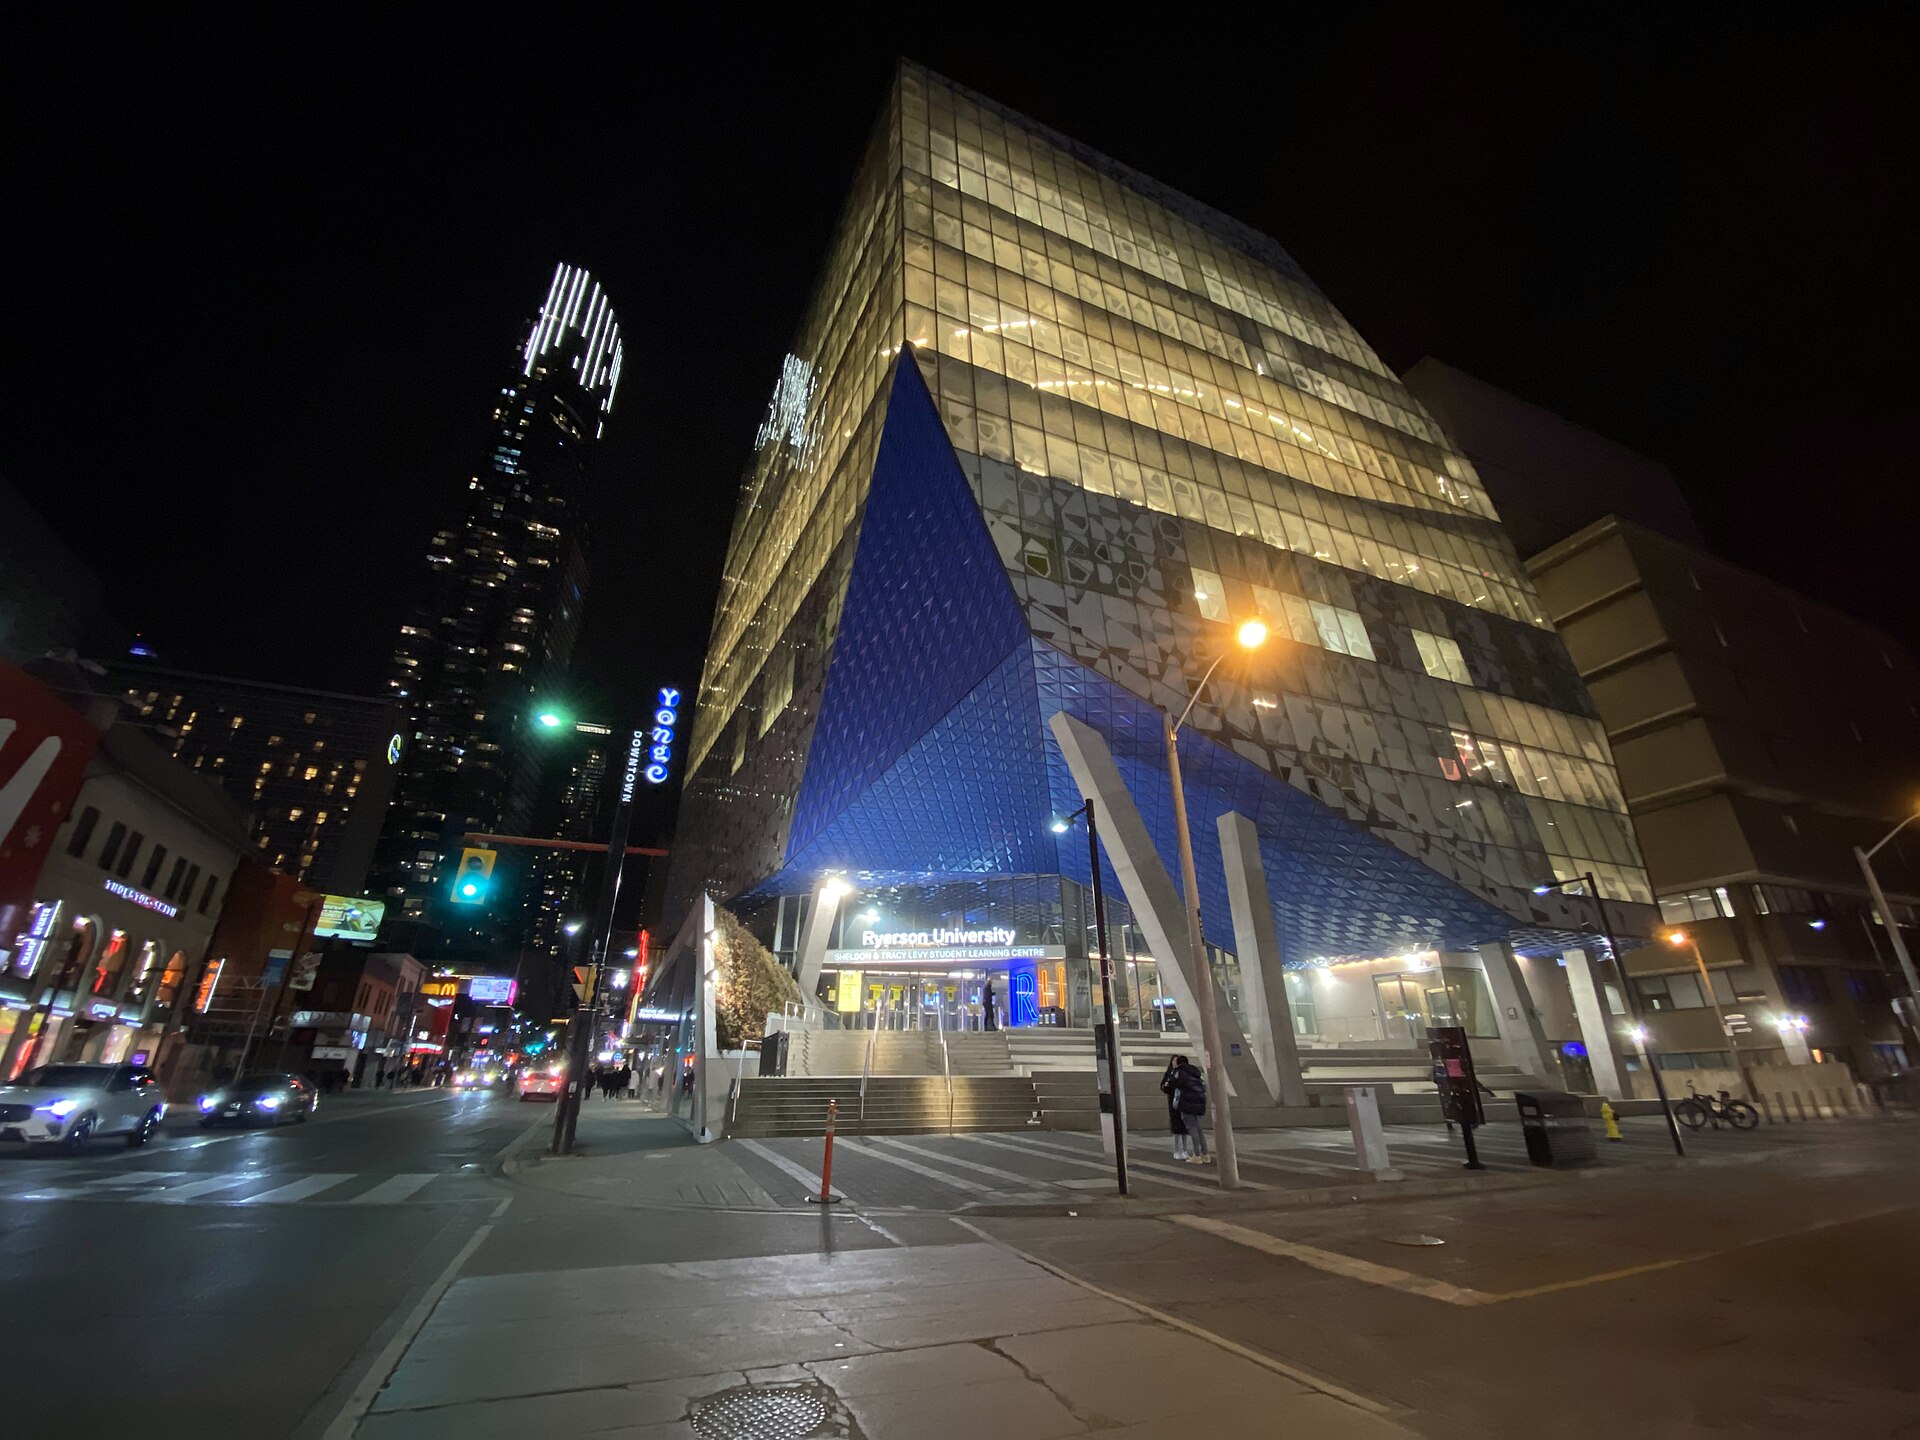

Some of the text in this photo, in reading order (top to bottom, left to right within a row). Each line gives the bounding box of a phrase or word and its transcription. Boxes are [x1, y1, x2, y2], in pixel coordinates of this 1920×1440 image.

[622, 731, 643, 803] DOWNTOWN
[862, 926, 1016, 949] Ryerson University
[834, 948, 1045, 961] SHELDON & TRACY LEVY STUDENT LEARNING CENTRE
